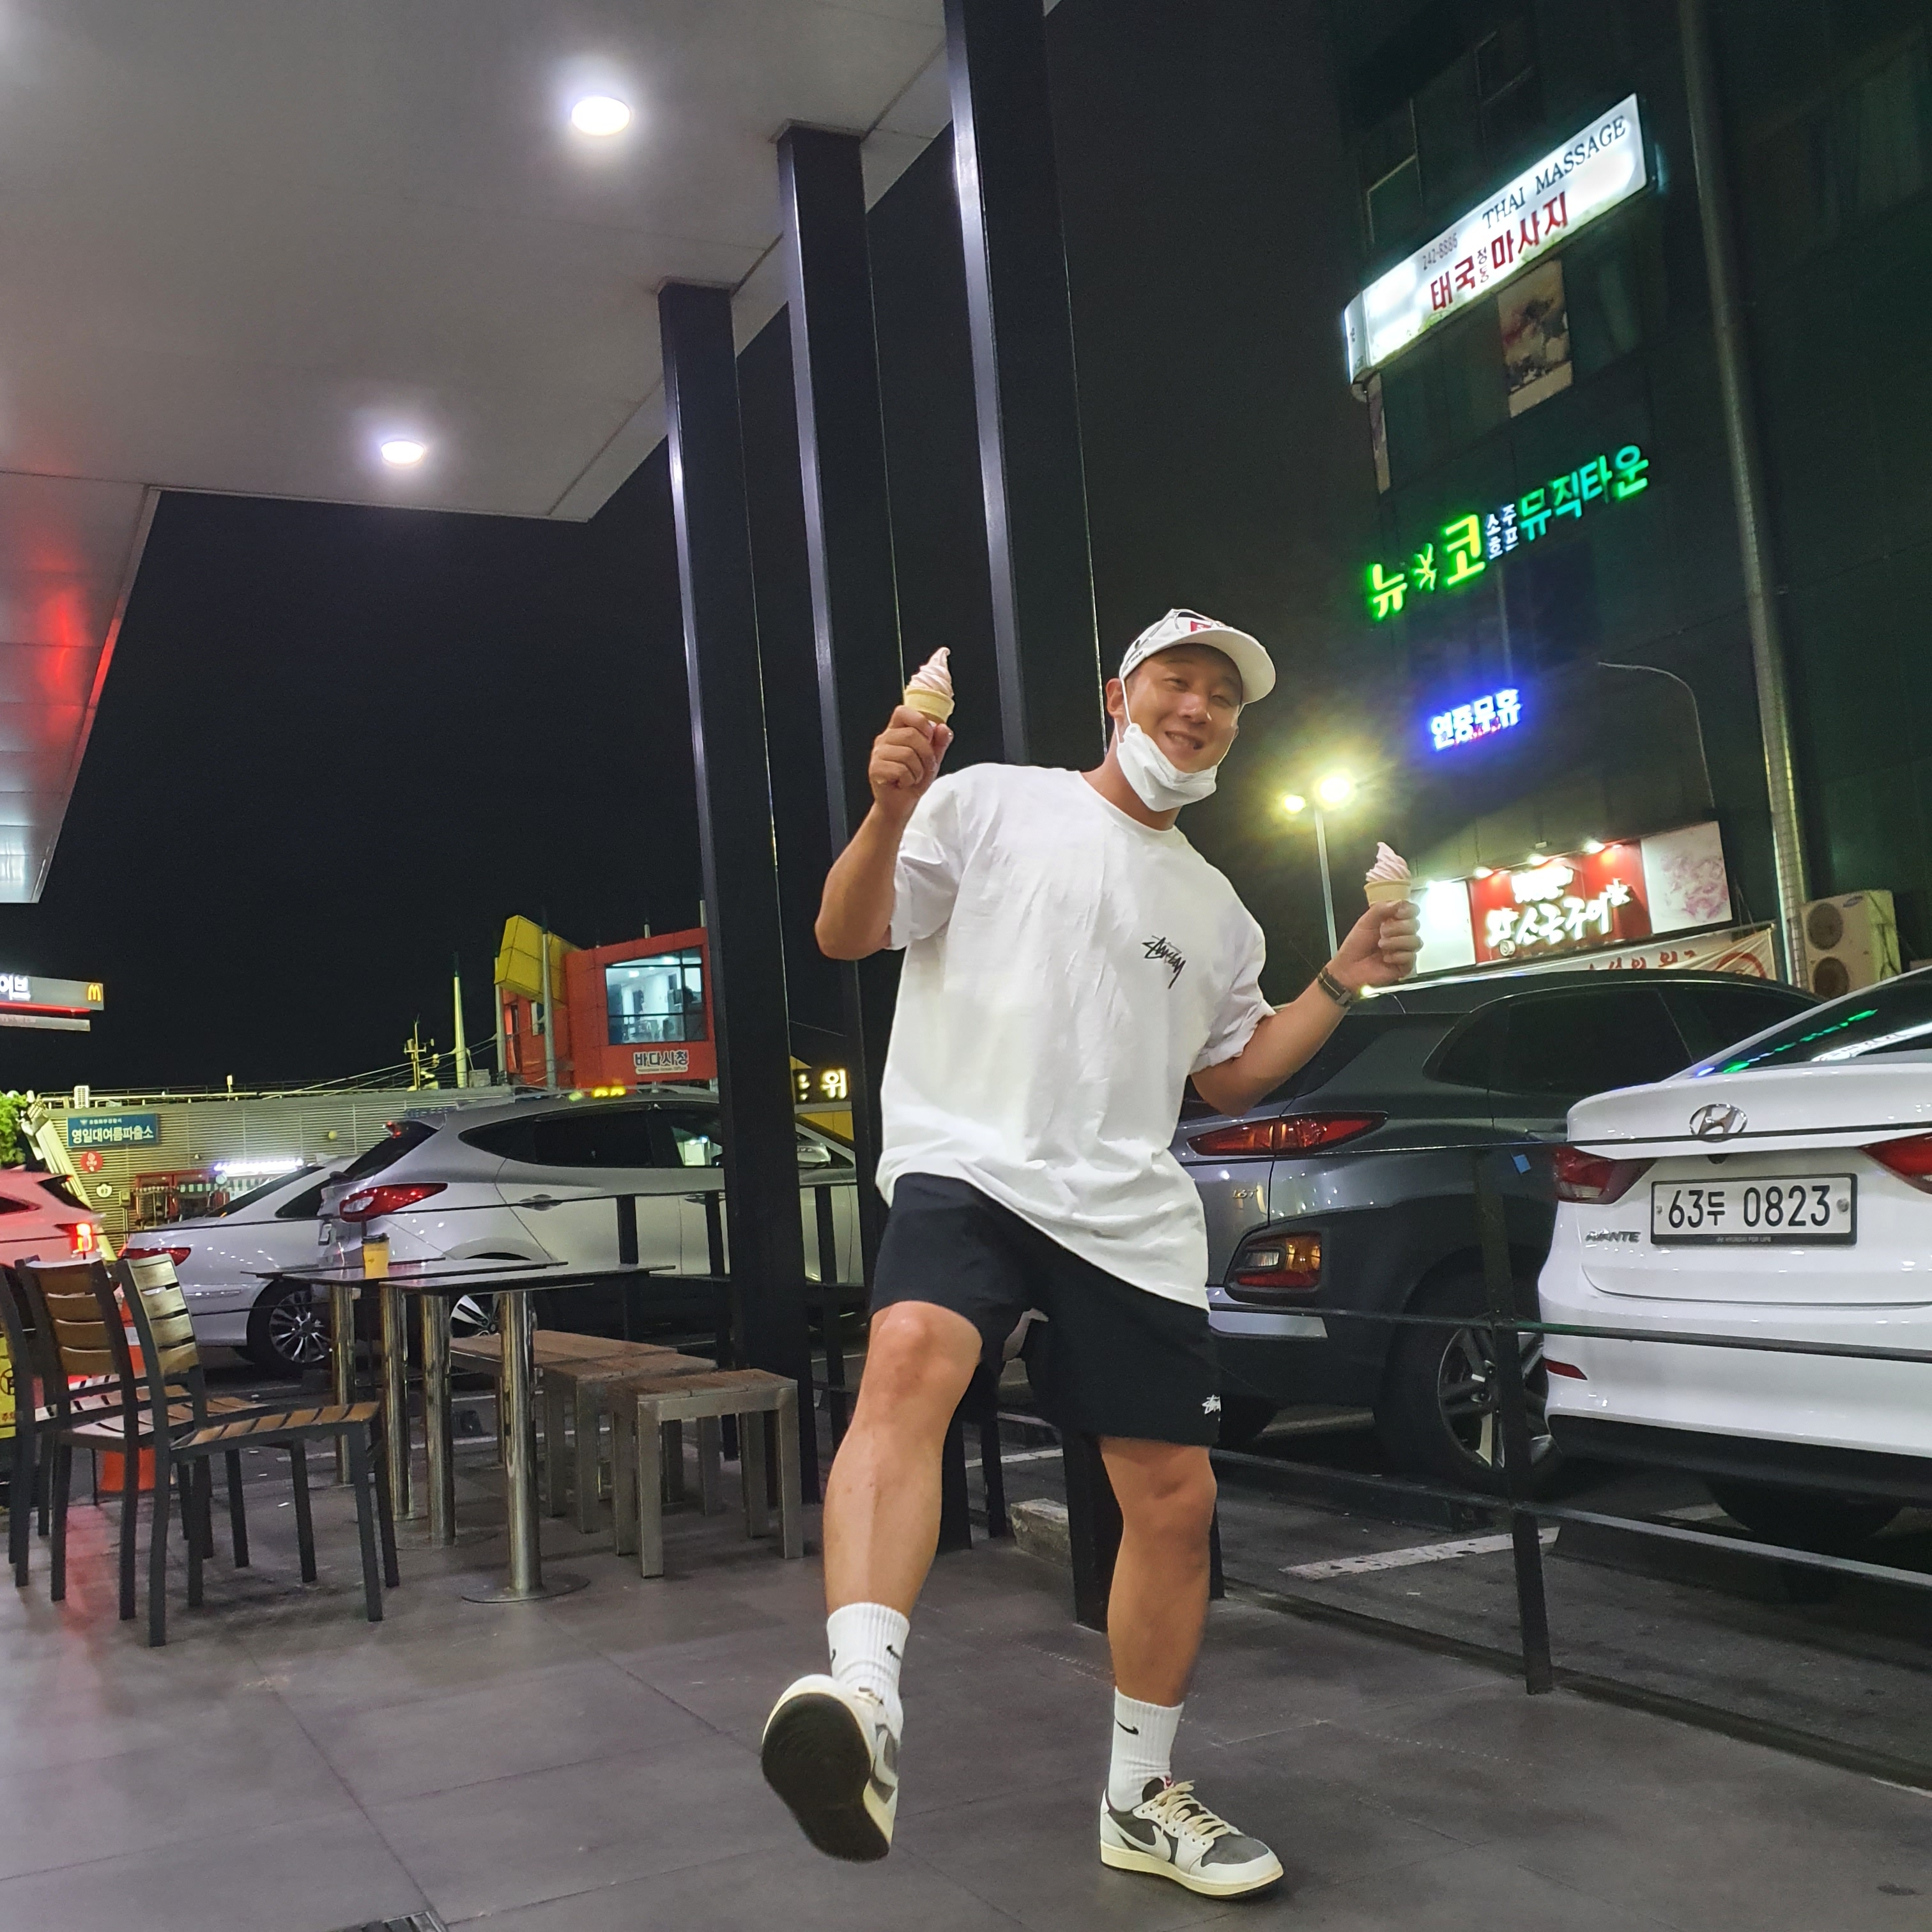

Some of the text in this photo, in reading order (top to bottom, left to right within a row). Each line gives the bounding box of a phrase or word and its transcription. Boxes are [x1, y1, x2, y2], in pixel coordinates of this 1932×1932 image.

[1482, 115, 1626, 229] THAI MASSAGE
[1430, 254, 1476, 311] 태국
[1491, 191, 1568, 269] 마사지
[1519, 445, 1649, 540] 뮤직타운
[1488, 526, 1519, 560] 호프
[1431, 689, 1521, 749] 연중무휴
[634, 1050, 688, 1066] 바다시청
[71, 1125, 155, 1144] 영일대여름파출소
[1668, 1184, 1830, 1229] 63두 0823
[1585, 1231, 1641, 1243] AVANTE
